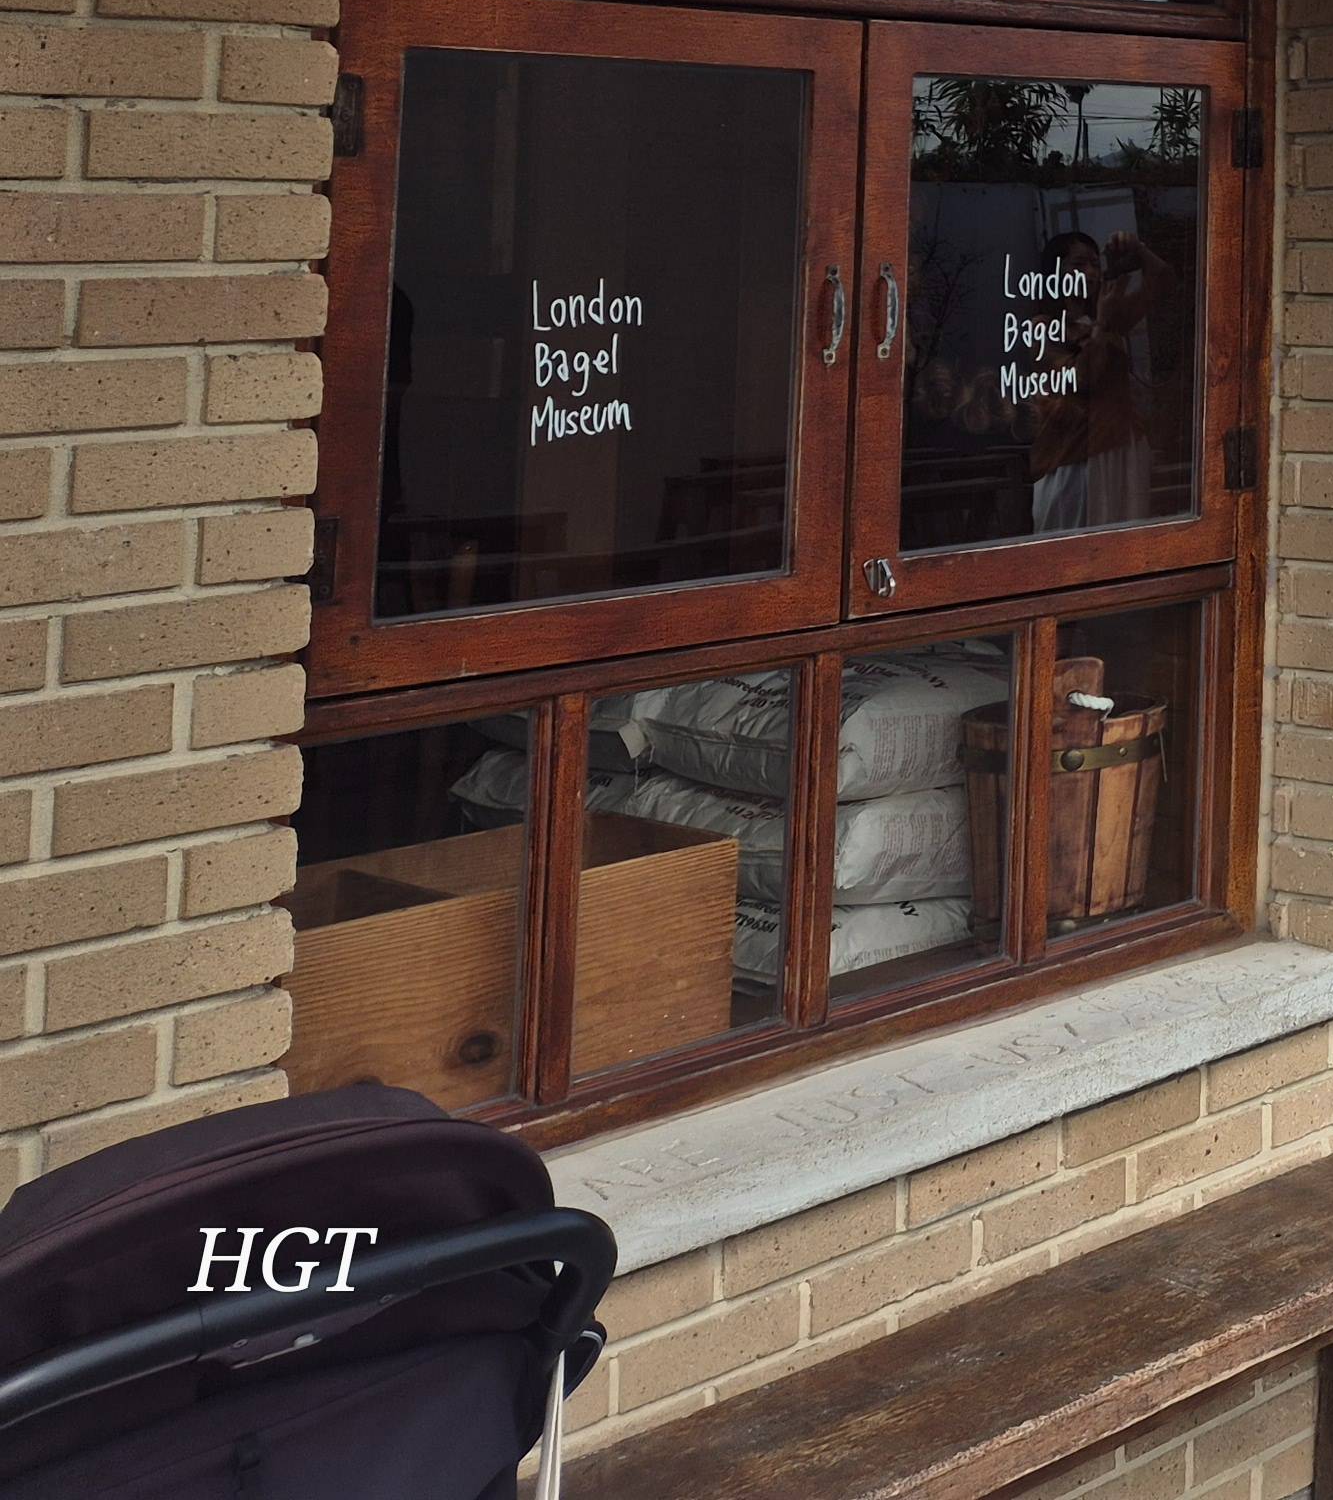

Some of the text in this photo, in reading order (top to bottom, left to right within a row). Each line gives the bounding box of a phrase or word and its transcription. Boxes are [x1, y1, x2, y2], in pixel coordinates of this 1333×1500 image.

[1004, 253, 1088, 300] London
[532, 278, 642, 331] London
[1004, 309, 1066, 362] Bagel
[535, 333, 619, 397] Bagel
[1000, 361, 1078, 405] Museum
[531, 396, 632, 447] Museum
